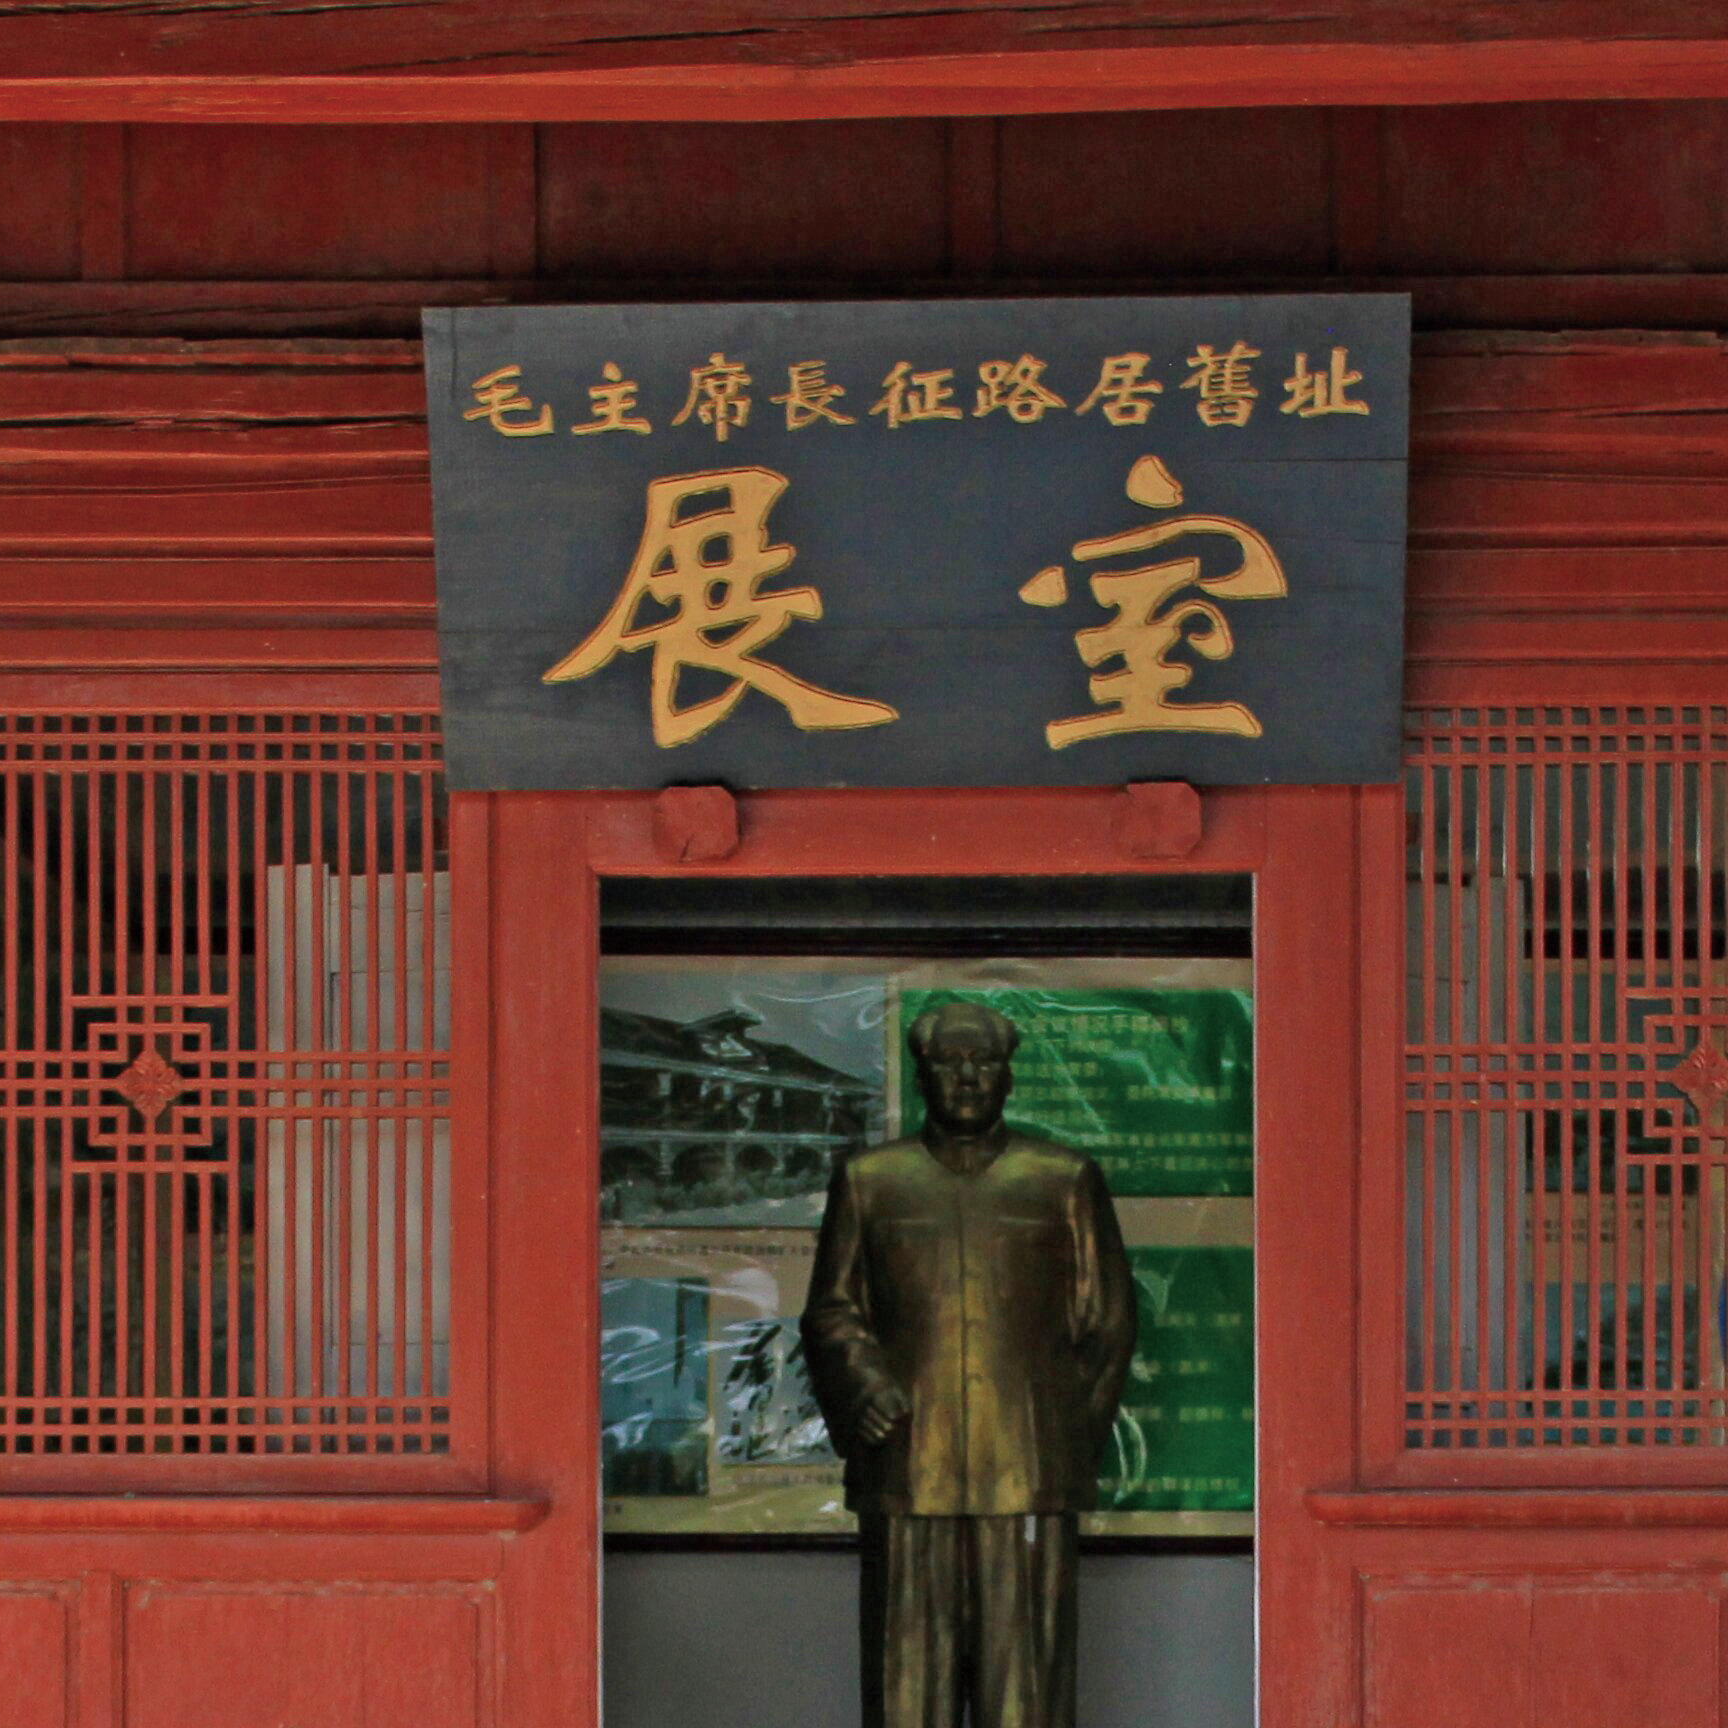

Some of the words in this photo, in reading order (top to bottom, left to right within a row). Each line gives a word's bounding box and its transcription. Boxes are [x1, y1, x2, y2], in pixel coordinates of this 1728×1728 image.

[463, 339, 1371, 443] 毛主席長征路居舊址
[540, 453, 1289, 751] 展室
